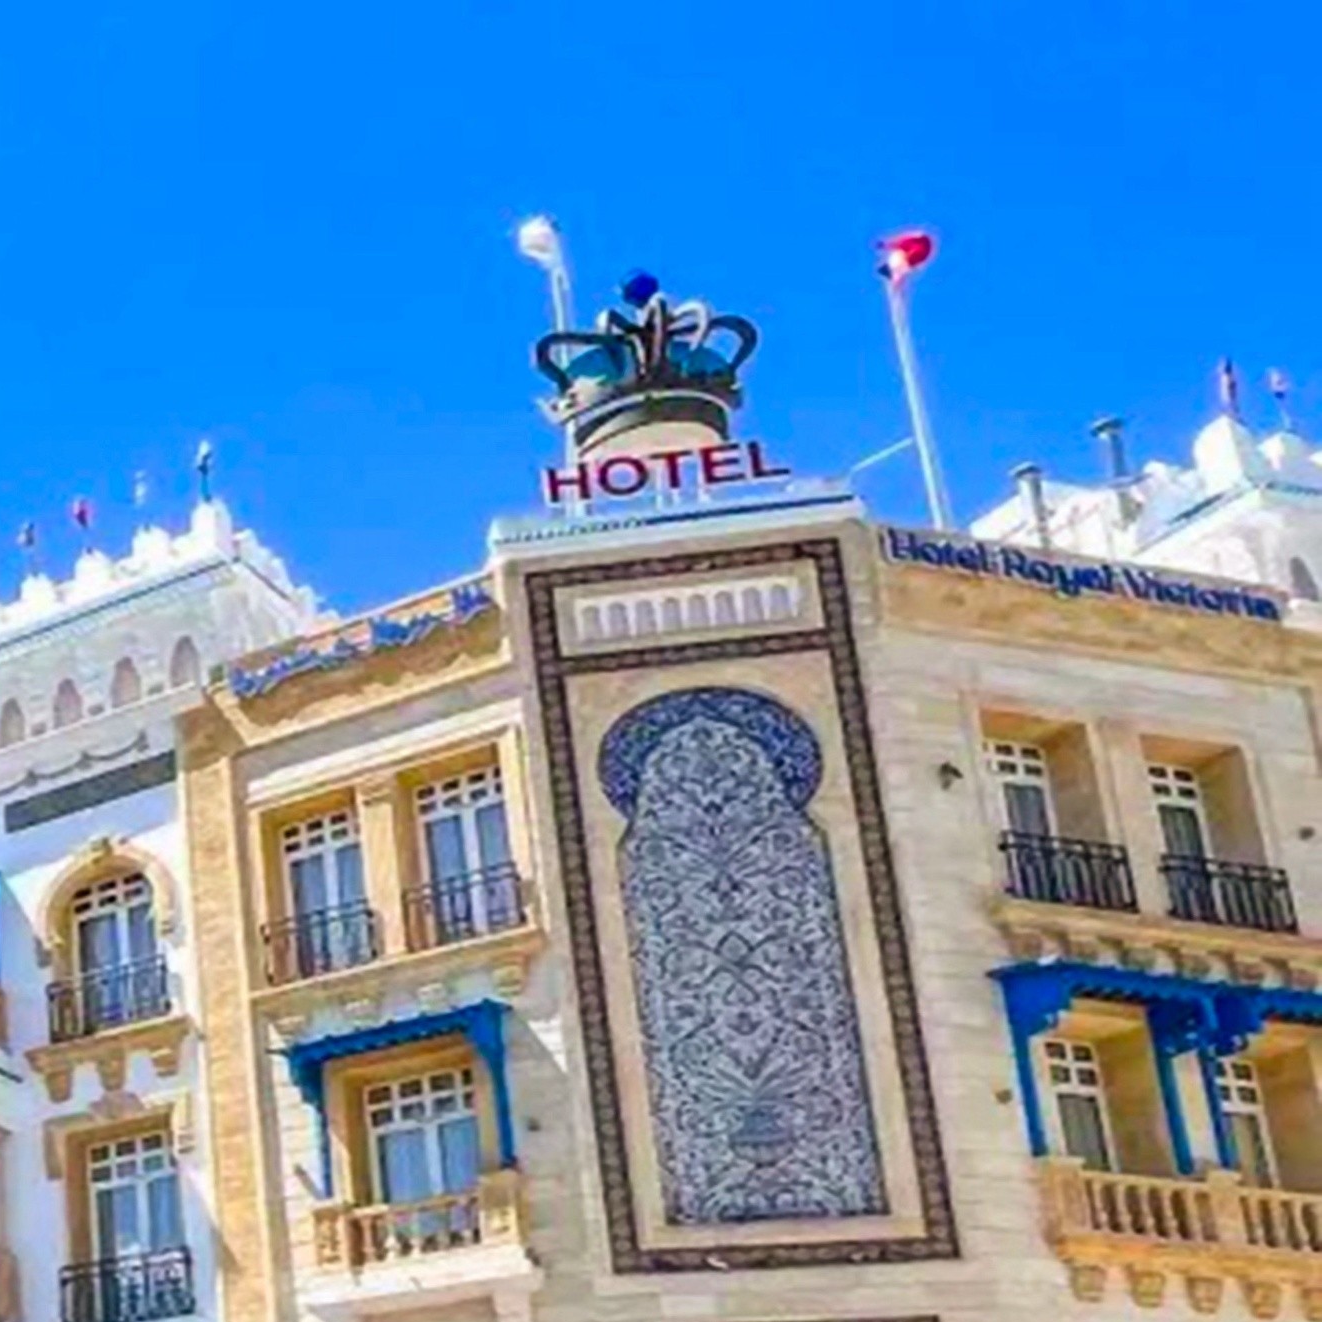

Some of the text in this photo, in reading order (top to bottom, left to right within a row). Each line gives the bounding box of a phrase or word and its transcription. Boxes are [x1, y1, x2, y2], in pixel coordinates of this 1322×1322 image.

[546, 441, 791, 503] HOTEL
[884, 528, 1282, 622] Hotel Royal Victoria
